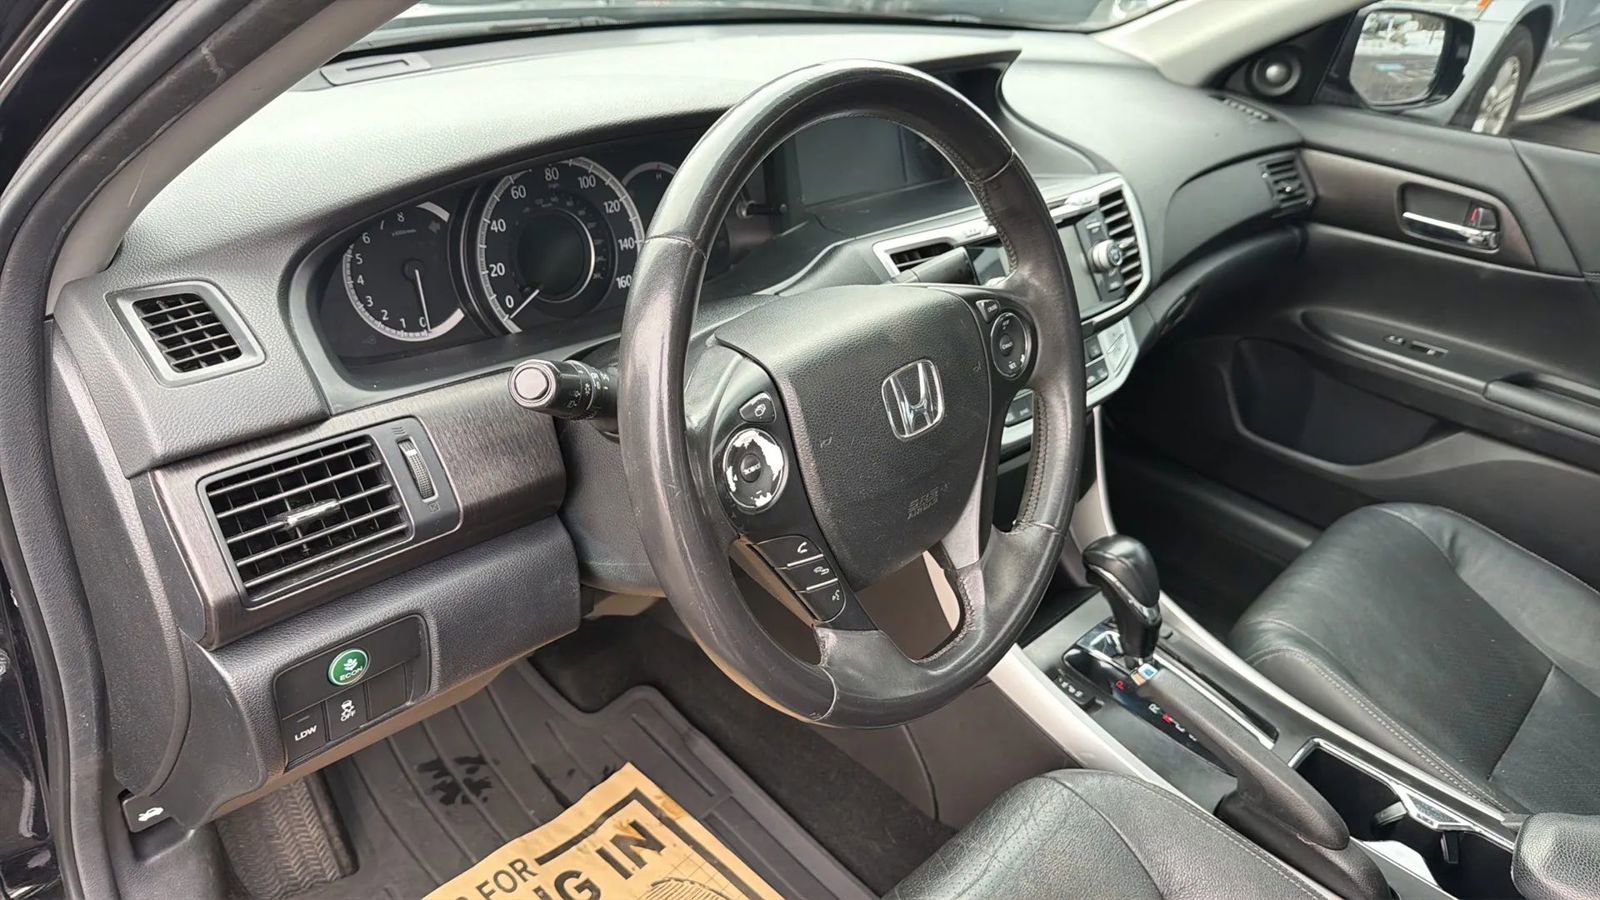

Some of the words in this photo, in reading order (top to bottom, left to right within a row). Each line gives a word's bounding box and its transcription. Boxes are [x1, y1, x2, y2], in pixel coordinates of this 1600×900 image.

[544, 166, 560, 181] 80
[577, 175, 597, 189] 100
[510, 184, 527, 199] 60
[603, 200, 621, 214] 120
[396, 211, 405, 222] 8
[490, 219, 506, 233] 40
[361, 231, 371, 244] 6
[617, 237, 636, 251] 140
[355, 253, 363, 265] 5
[489, 262, 506, 277] 20
[356, 274, 365, 286] 4
[615, 274, 632, 289] 160
[365, 295, 374, 307] 3
[505, 295, 514, 308] 0
[380, 309, 389, 321] 2
[419, 316, 427, 328] 0
[399, 317, 406, 329] 1
[339, 665, 364, 682] ECON
[1148, 703, 1160, 714] R
[340, 710, 356, 722] OFF
[294, 724, 318, 741] LDW
[595, 819, 667, 881] IN
[475, 857, 538, 900] FOR
